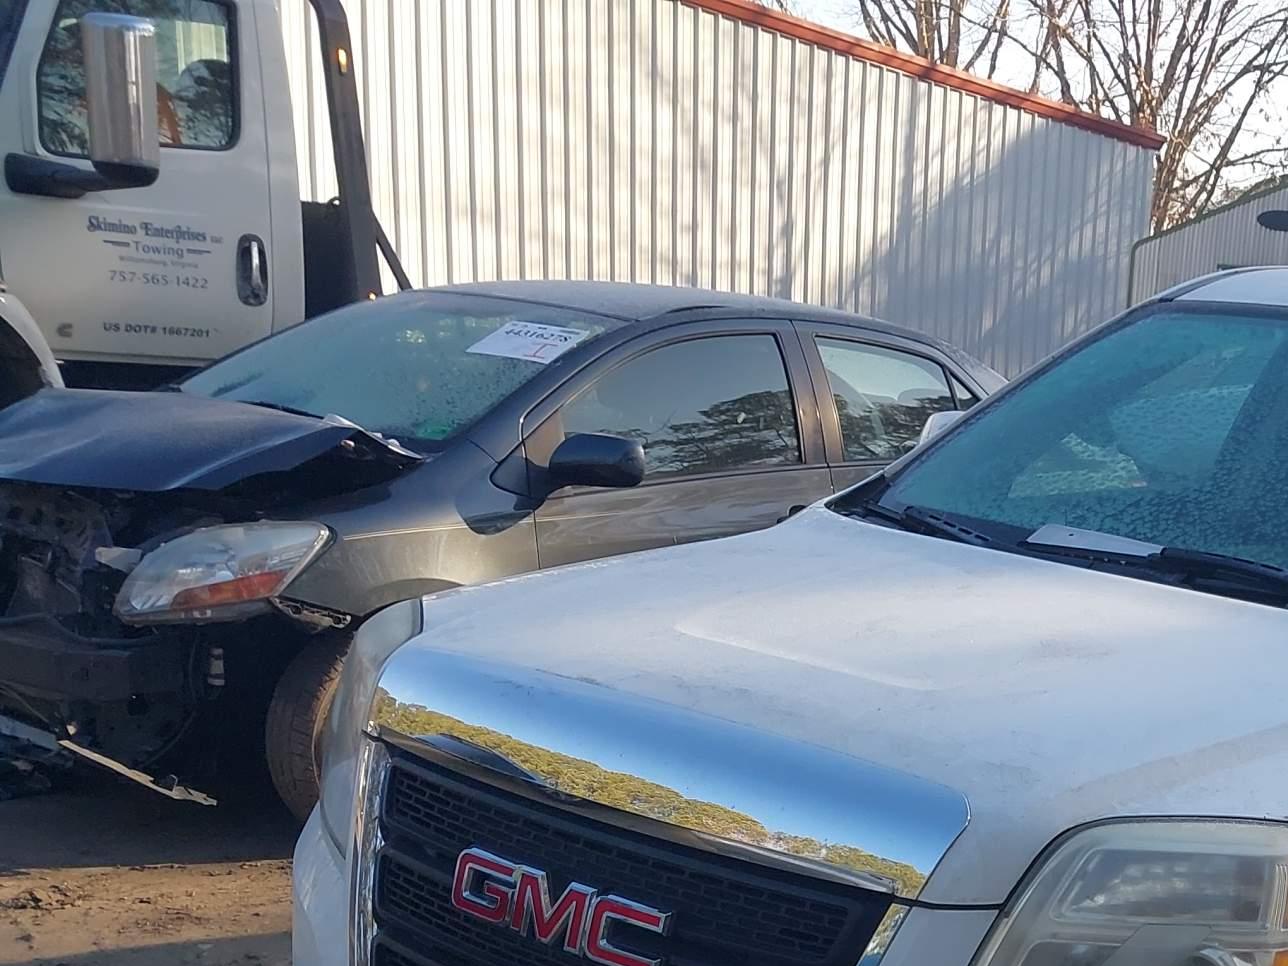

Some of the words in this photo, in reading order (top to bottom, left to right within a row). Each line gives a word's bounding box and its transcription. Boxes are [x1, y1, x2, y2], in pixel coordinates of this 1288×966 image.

[87, 215, 137, 235] Skimino
[140, 222, 207, 243] Enterprises
[133, 241, 185, 259] Towing
[108, 269, 208, 289] 757-565-1422
[103, 322, 120, 333] US
[124, 323, 157, 335] DOT#
[161, 326, 210, 338] 1667201
